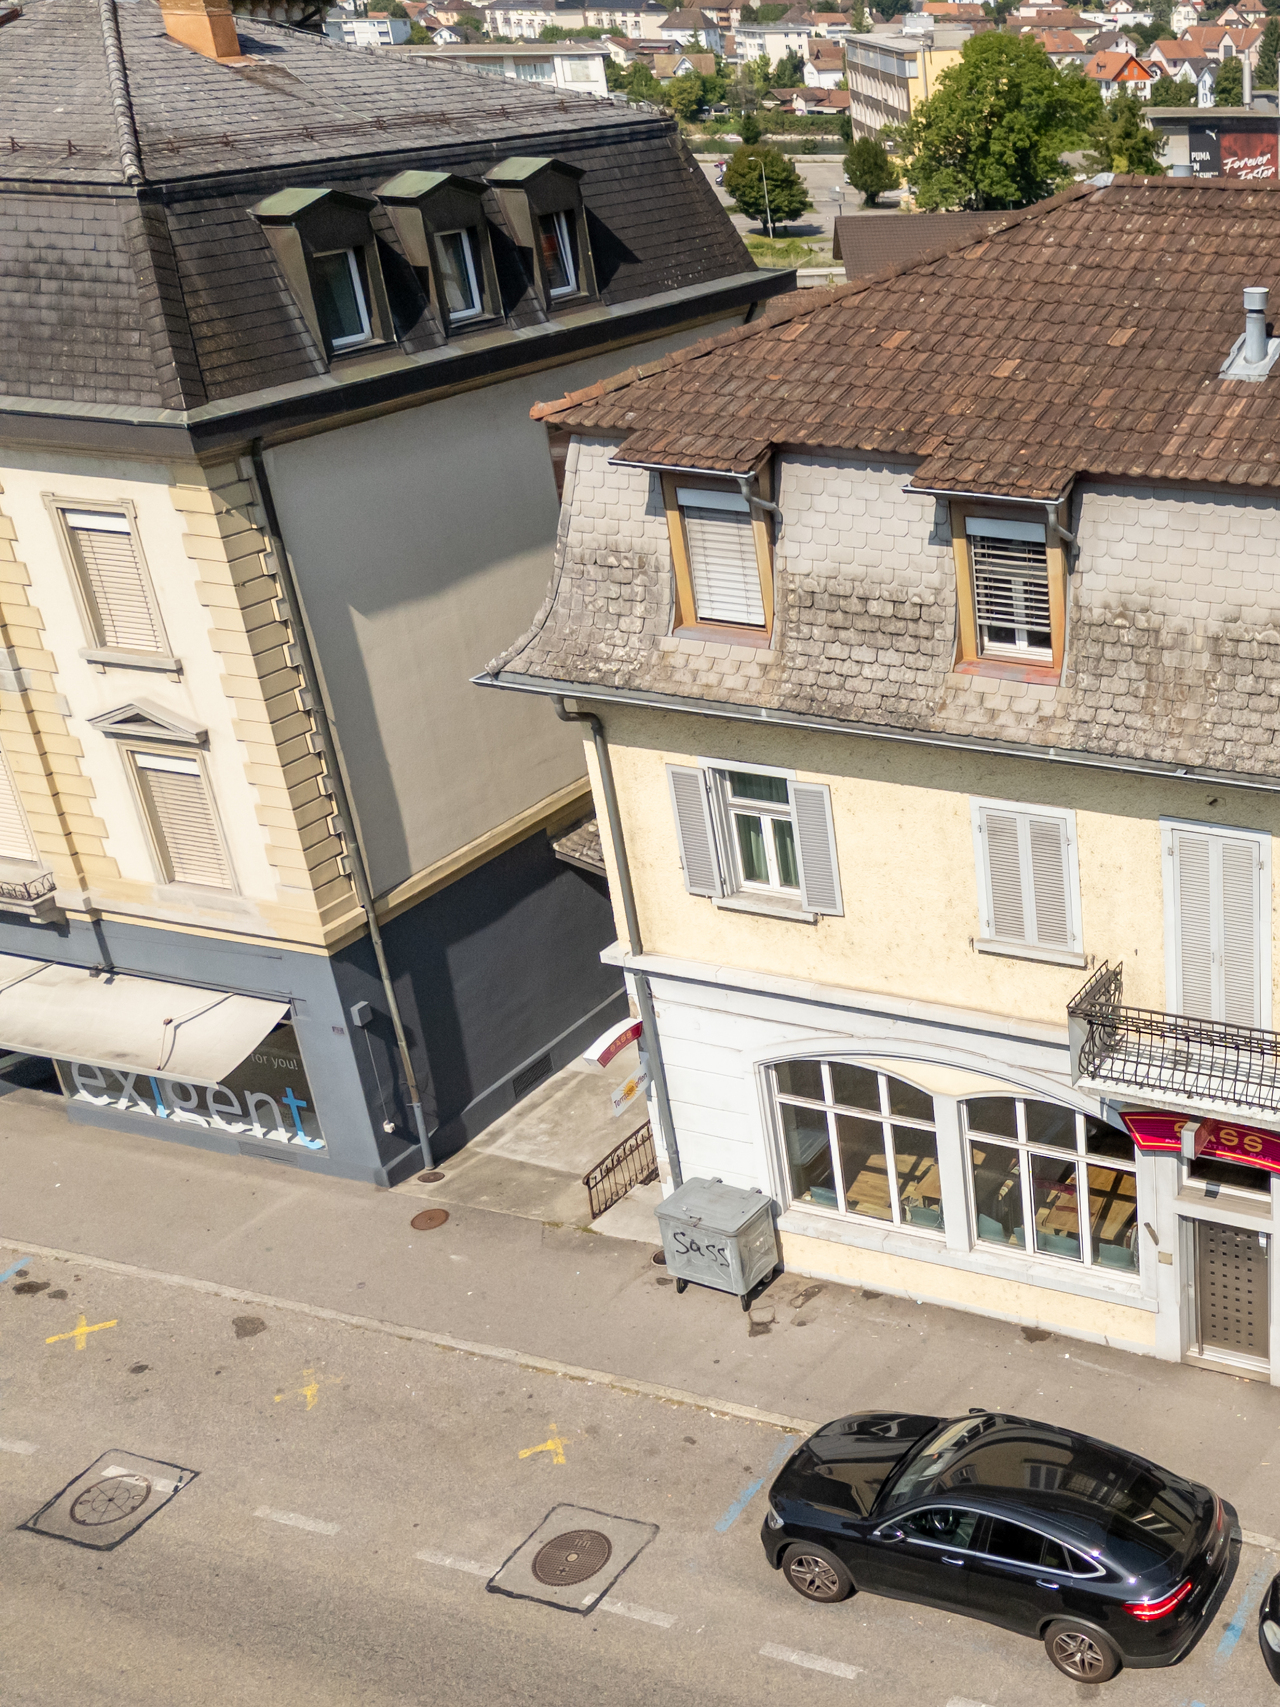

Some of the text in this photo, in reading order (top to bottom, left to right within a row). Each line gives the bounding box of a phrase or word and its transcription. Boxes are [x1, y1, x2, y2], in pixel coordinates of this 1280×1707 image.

[1191, 151, 1211, 161] PUMA
[1223, 153, 1271, 173] Forever
[271, 1057, 298, 1070] you!
